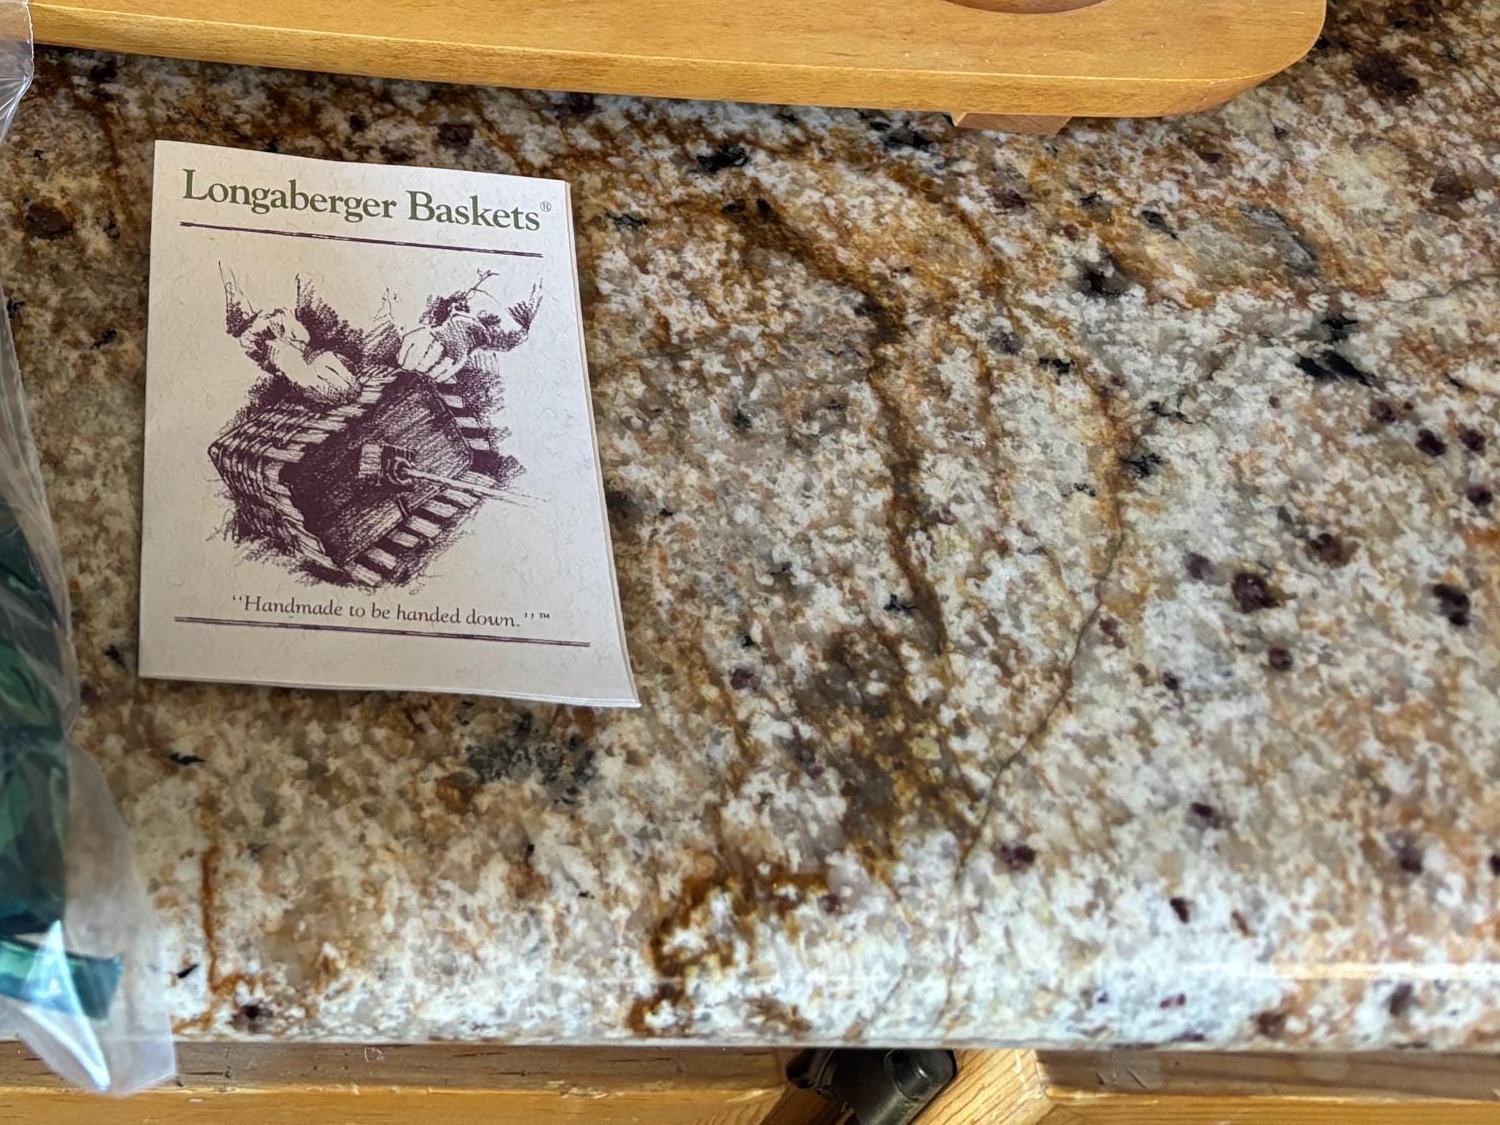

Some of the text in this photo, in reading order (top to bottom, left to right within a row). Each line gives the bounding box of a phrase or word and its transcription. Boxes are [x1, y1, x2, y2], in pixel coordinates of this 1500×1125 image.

[182, 168, 398, 224] Longaberger
[350, 605, 366, 619] to
[372, 603, 391, 621] be
[396, 604, 461, 625] handed
